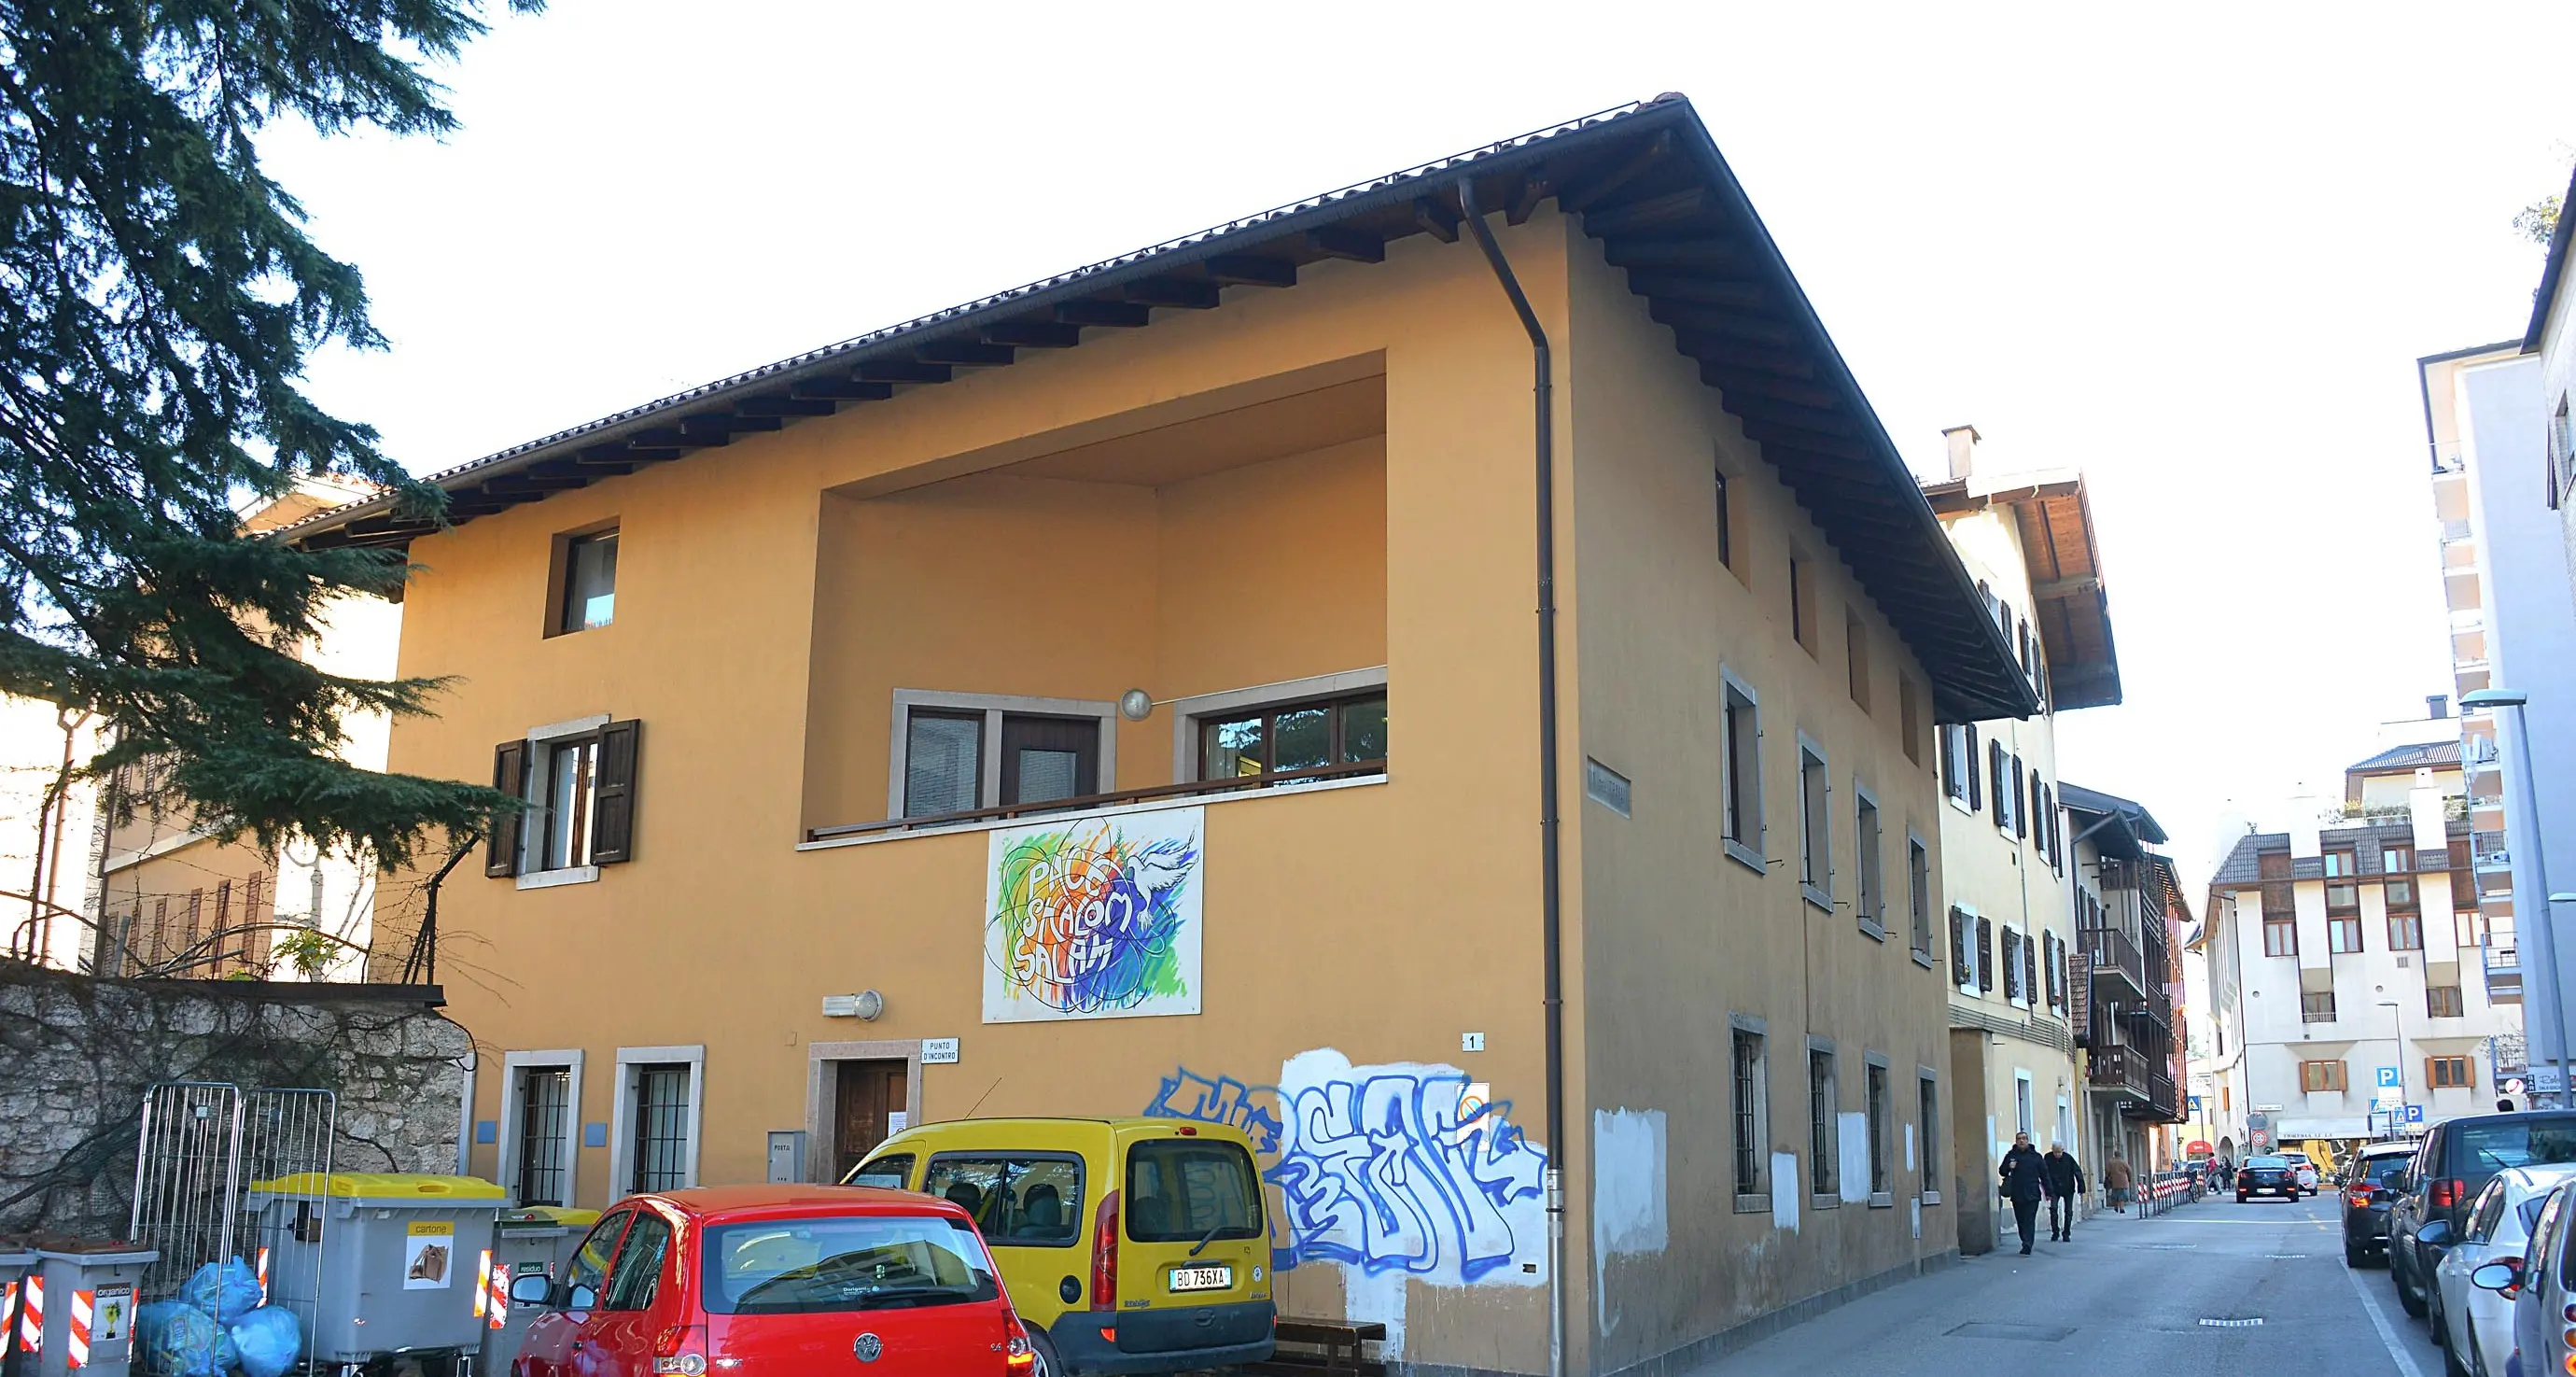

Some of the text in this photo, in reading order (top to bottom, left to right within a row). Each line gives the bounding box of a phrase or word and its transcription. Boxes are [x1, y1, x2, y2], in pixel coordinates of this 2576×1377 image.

[1023, 891, 1133, 943] SHALOM
[1014, 935, 1113, 983] SALAM
[930, 1042, 950, 1050] PUNTO
[1469, 1035, 1475, 1048] 1
[415, 1224, 447, 1233] cartone
[521, 1263, 541, 1272] residuo
[1177, 1270, 1224, 1286] BD 736XA
[97, 1286, 131, 1298] organico
